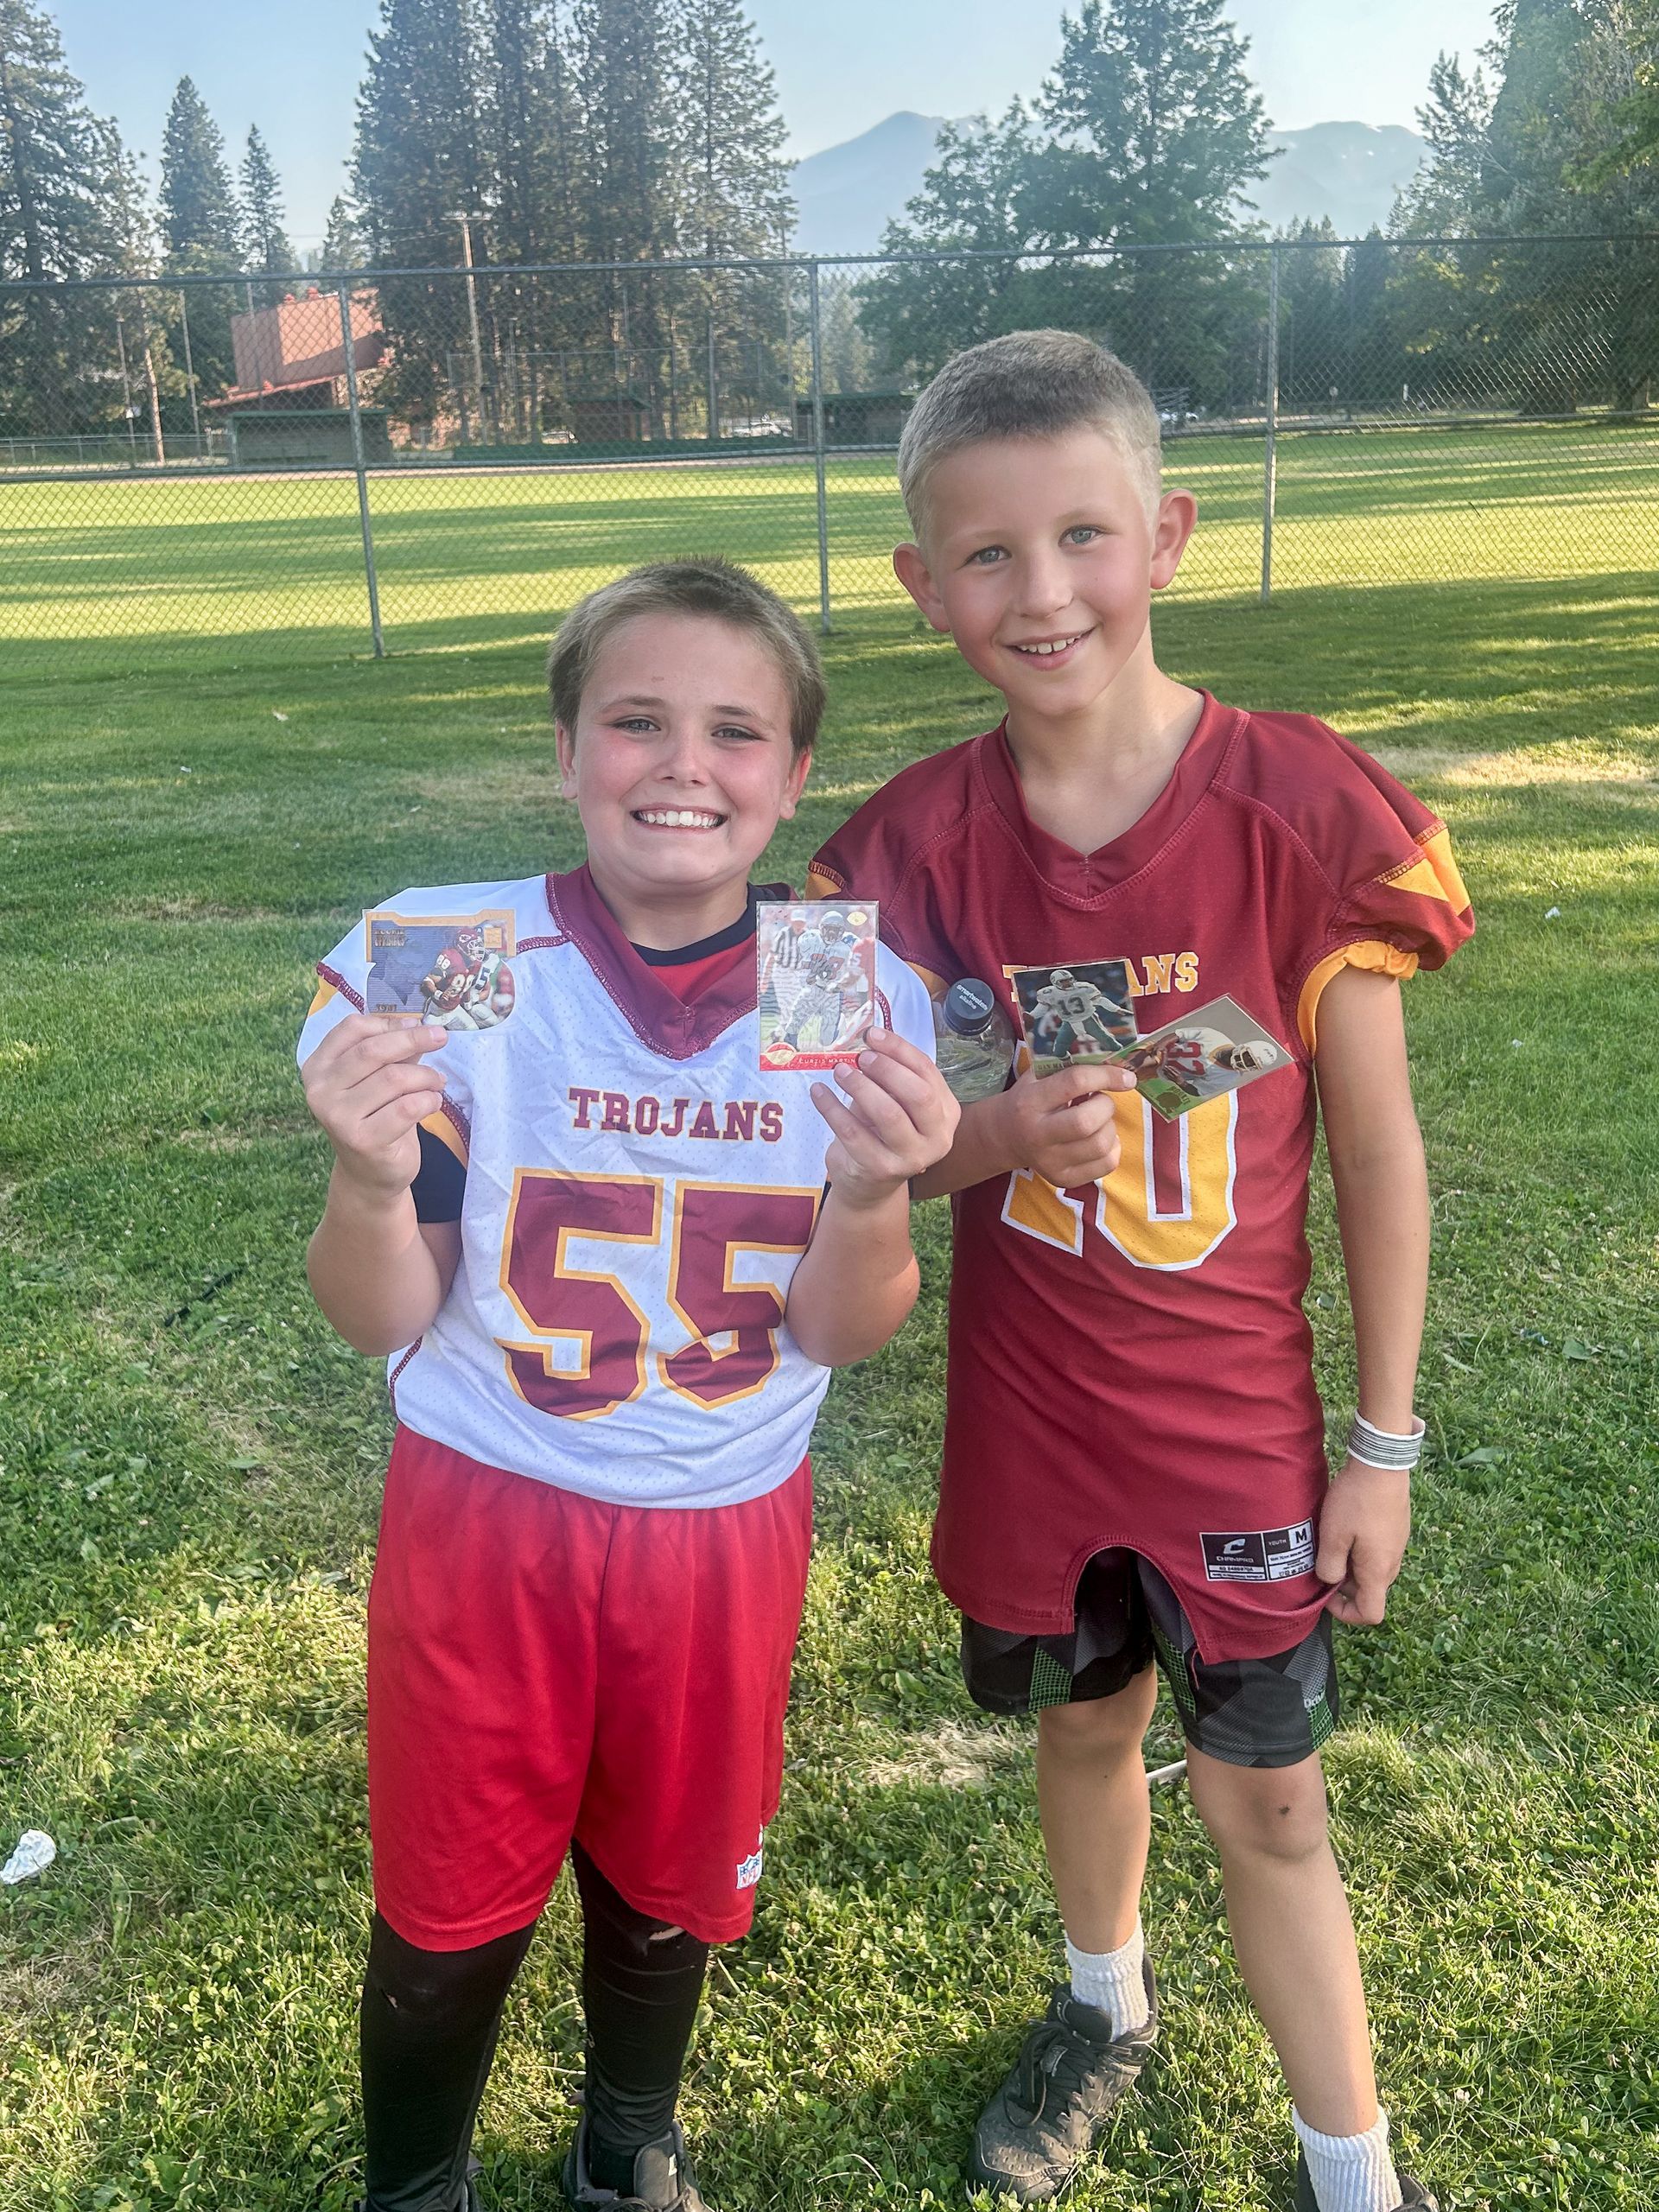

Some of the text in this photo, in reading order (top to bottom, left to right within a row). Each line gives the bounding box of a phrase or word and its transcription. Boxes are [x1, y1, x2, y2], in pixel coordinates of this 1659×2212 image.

[956, 983, 988, 1011] smartwater
[1058, 996, 1086, 1016] 13
[568, 1086, 784, 1142] TROJANS
[493, 1166, 823, 1422] 55
[1295, 1528, 1308, 1544] M
